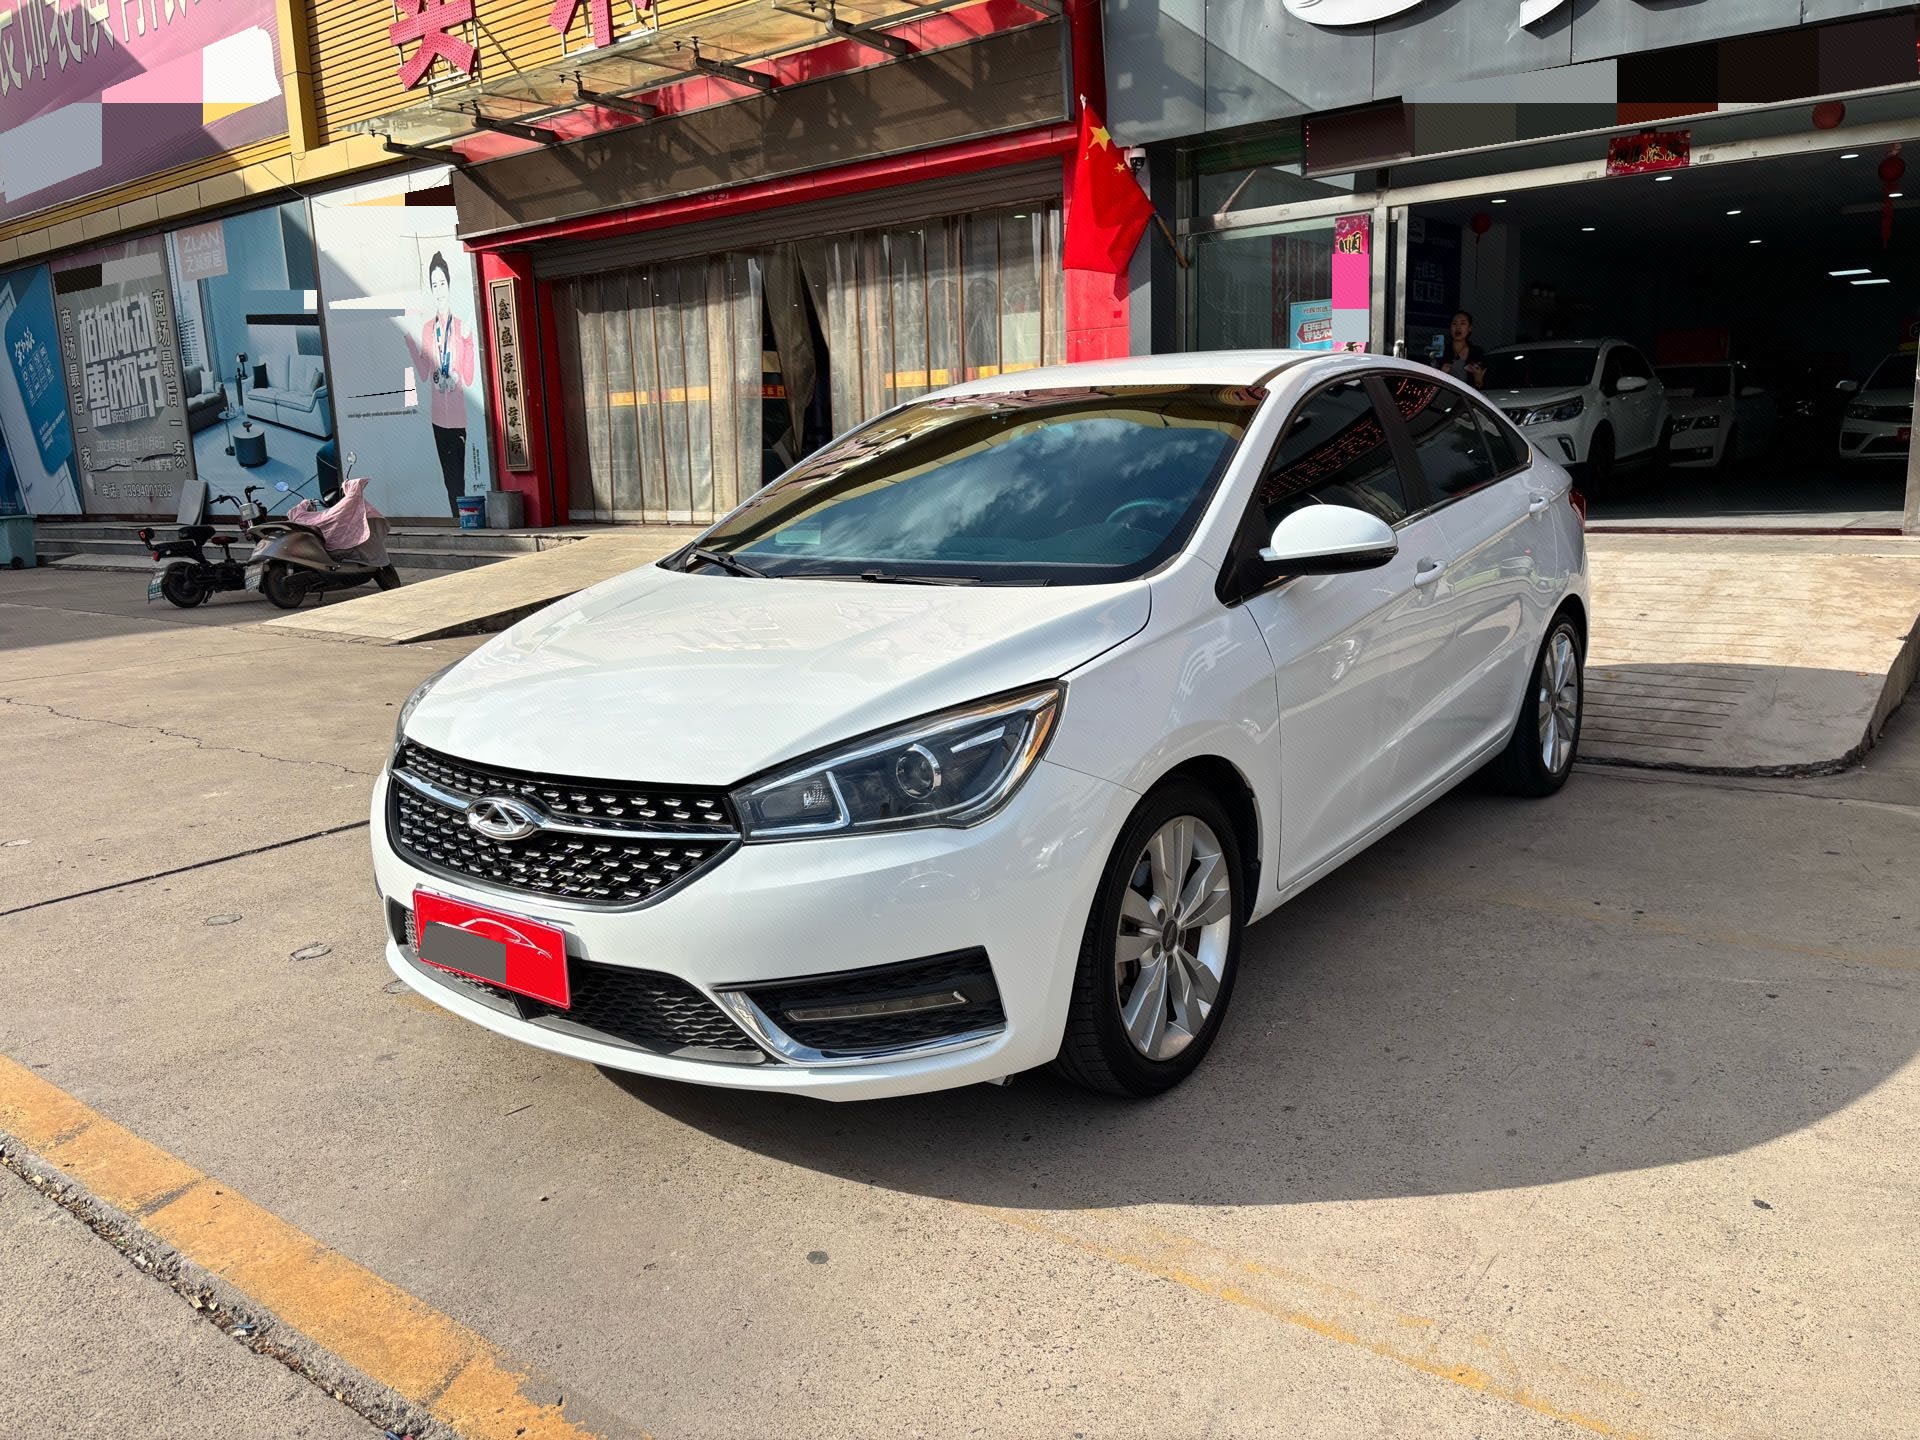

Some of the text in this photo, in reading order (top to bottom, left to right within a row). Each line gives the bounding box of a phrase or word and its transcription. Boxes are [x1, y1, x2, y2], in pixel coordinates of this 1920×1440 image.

[61, 308, 93, 472] 商场最后一家
[152, 289, 188, 468] 商场最后一家
